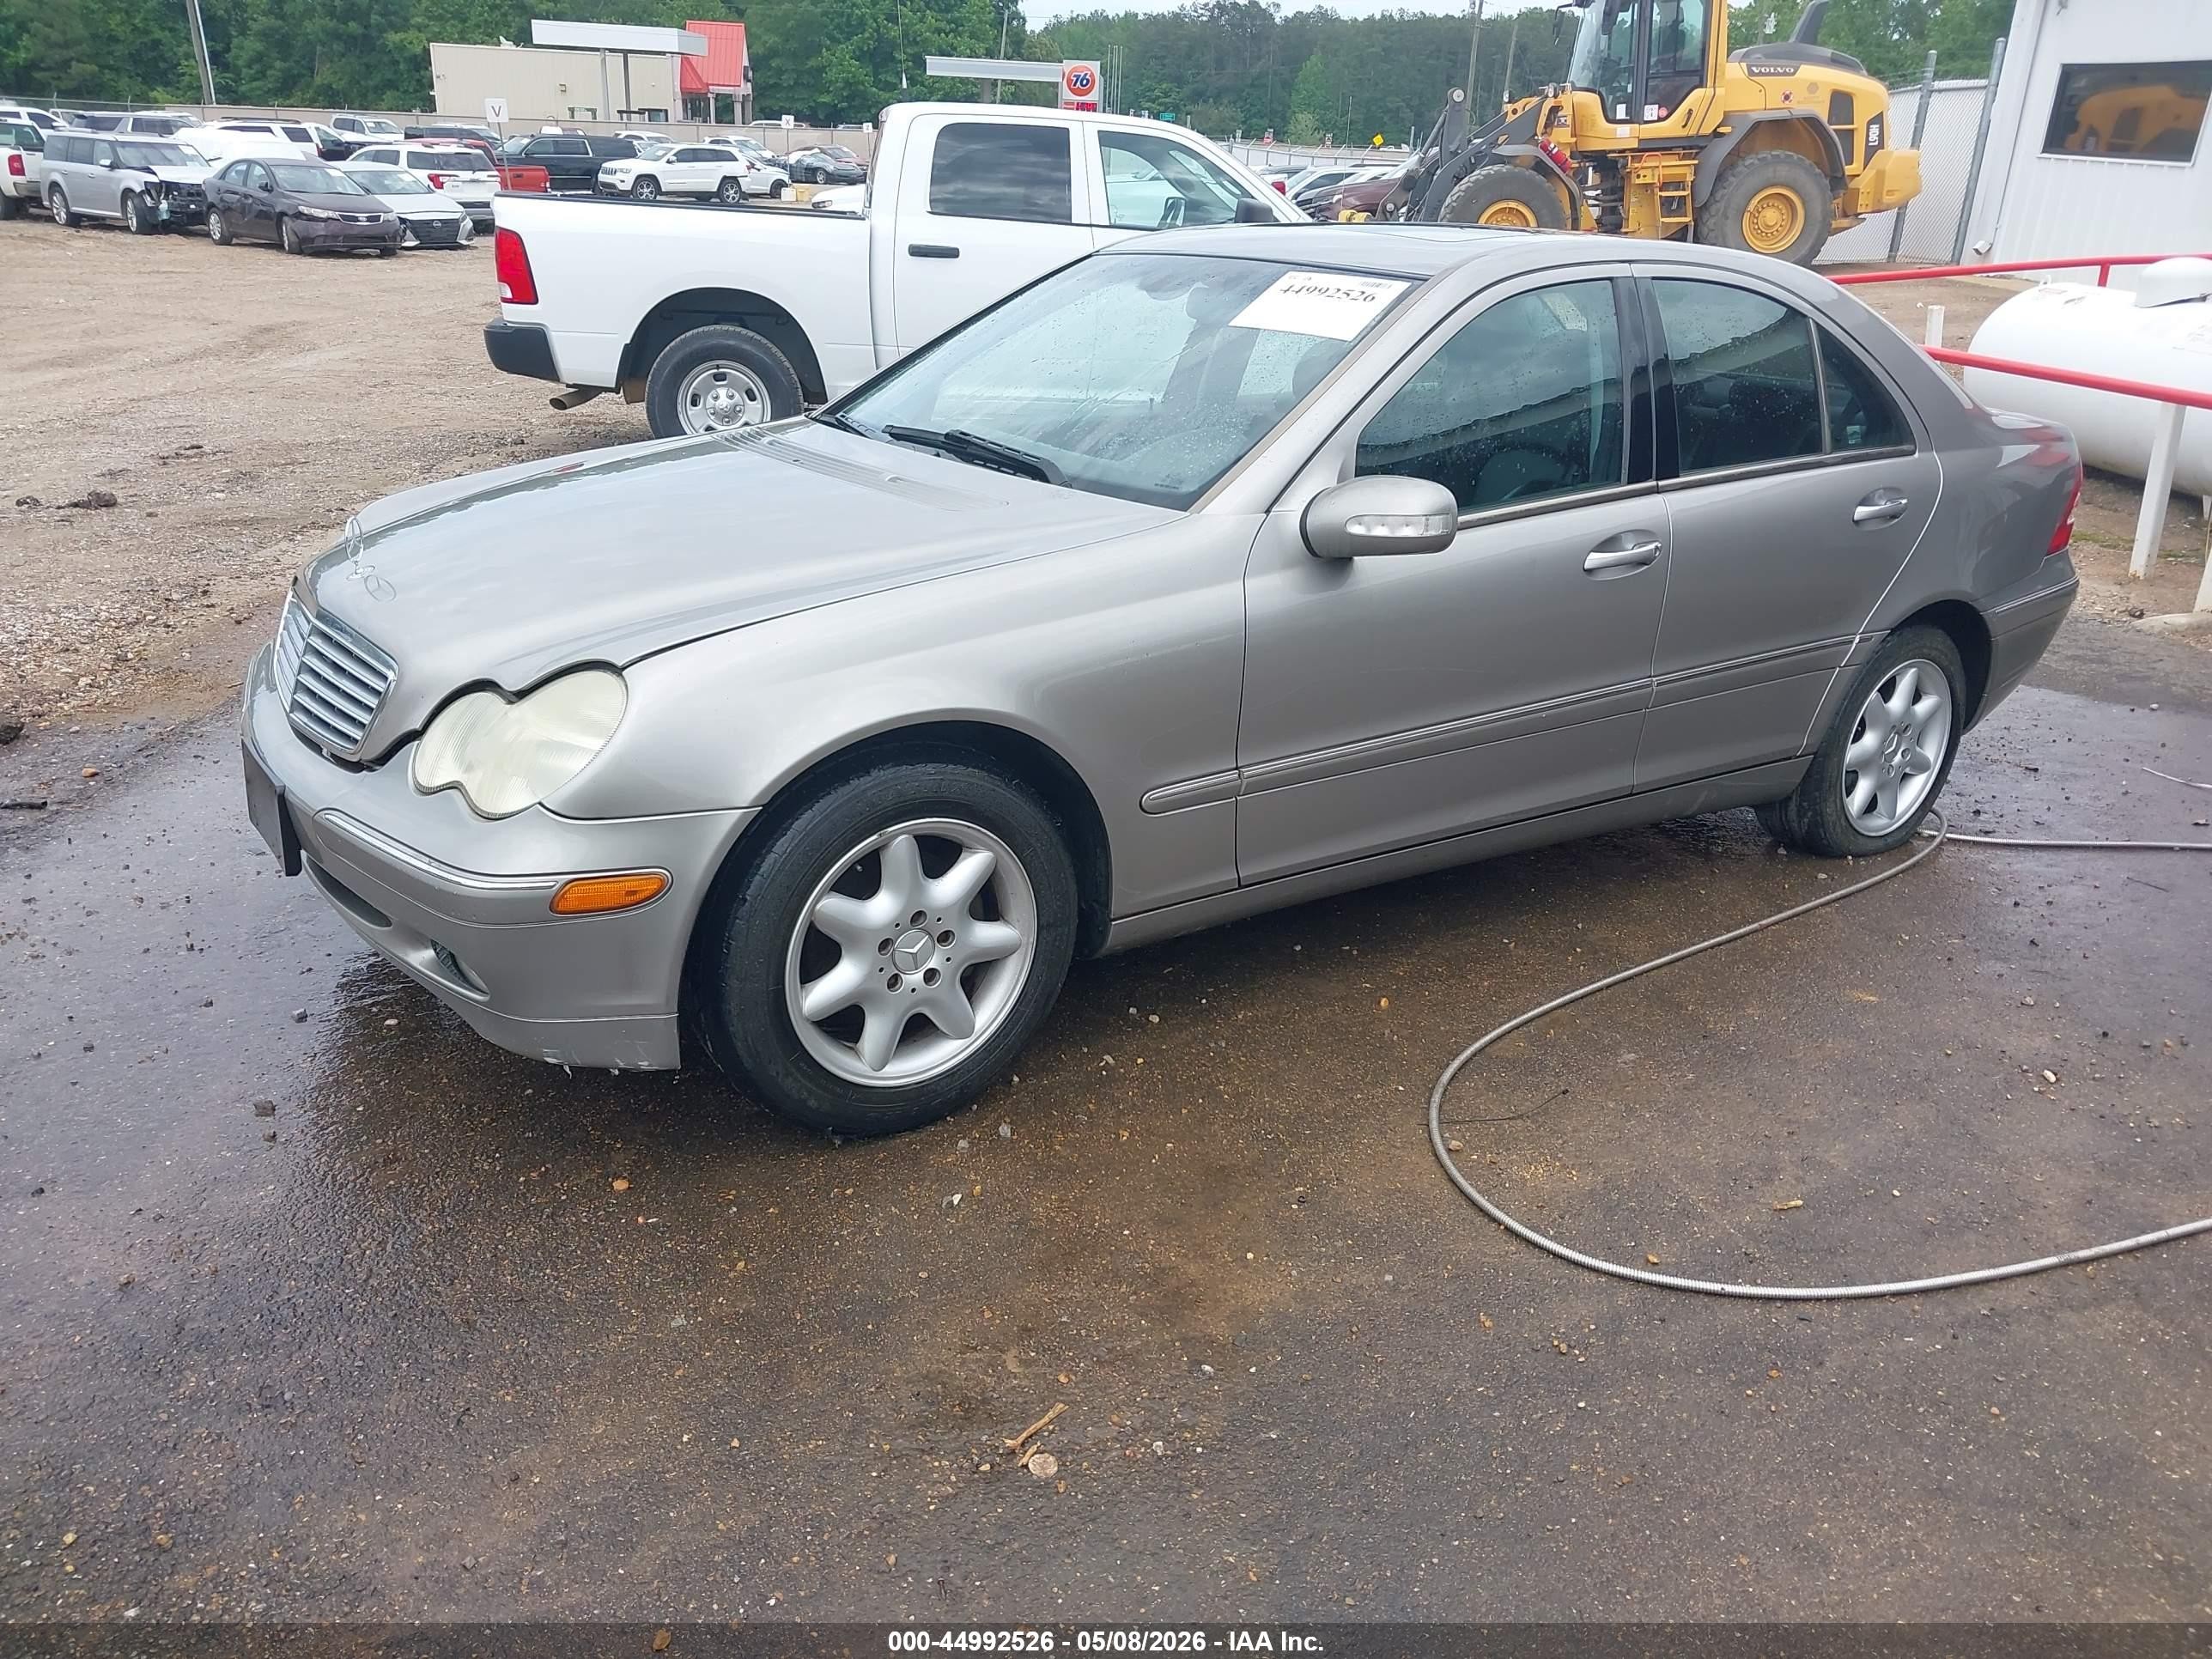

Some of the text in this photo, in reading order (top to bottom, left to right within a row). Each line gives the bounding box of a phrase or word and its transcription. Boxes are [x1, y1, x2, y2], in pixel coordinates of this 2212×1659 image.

[1071, 71, 1091, 88] 76
[491, 105, 501, 118] V
[1868, 124, 1880, 146] L90H
[1279, 283, 1376, 303] 44992526
